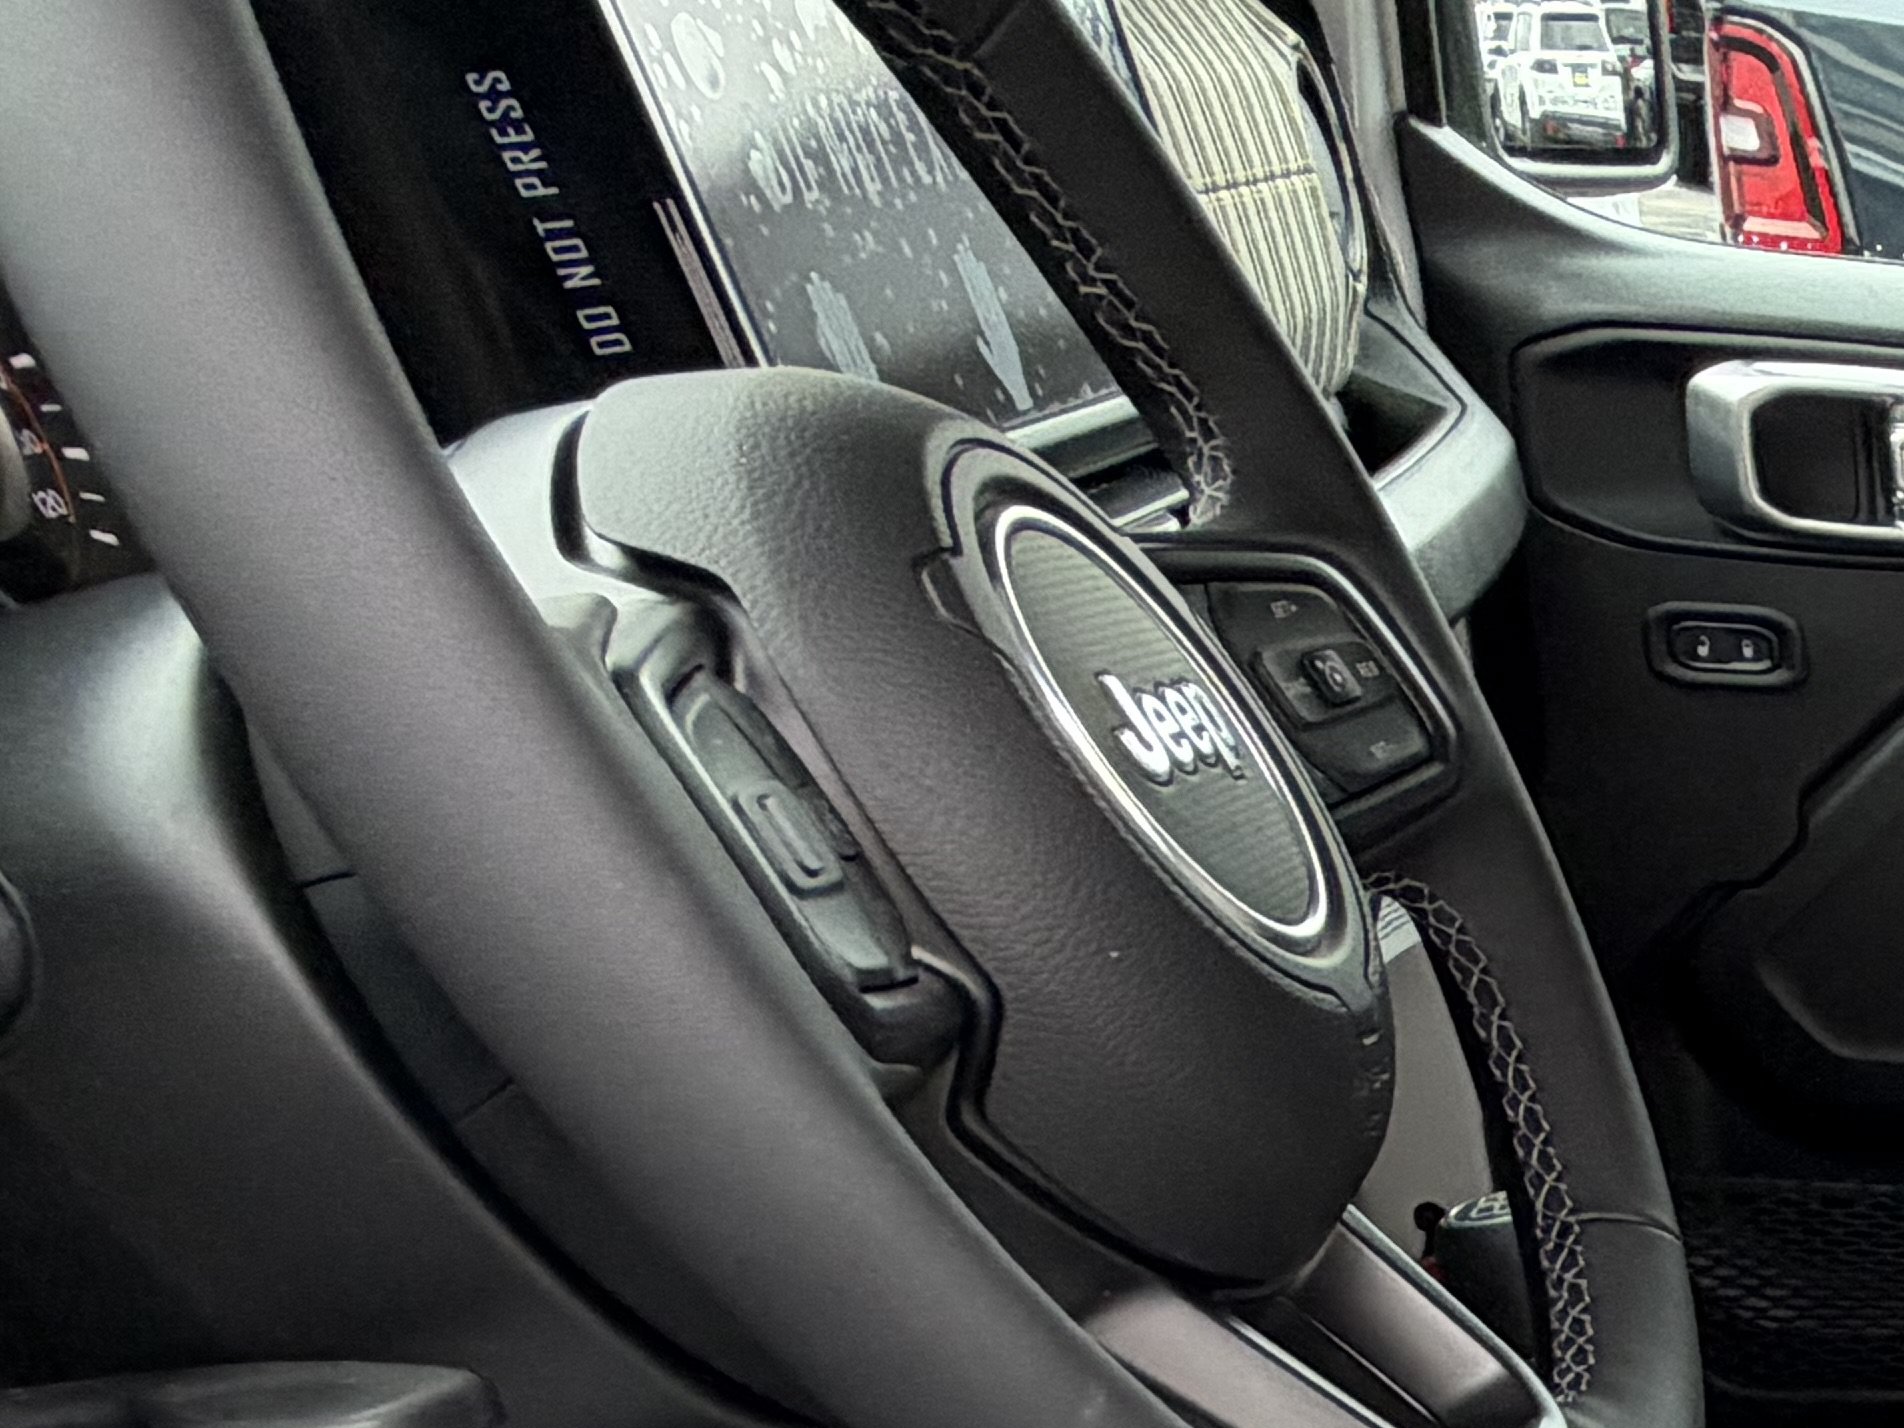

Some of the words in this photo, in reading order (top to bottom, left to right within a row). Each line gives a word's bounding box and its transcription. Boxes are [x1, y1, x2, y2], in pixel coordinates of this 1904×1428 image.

[466, 68, 559, 197] PRESS
[533, 216, 602, 290] NOT
[576, 306, 633, 356] DO
[1098, 670, 1247, 785] Jeep
